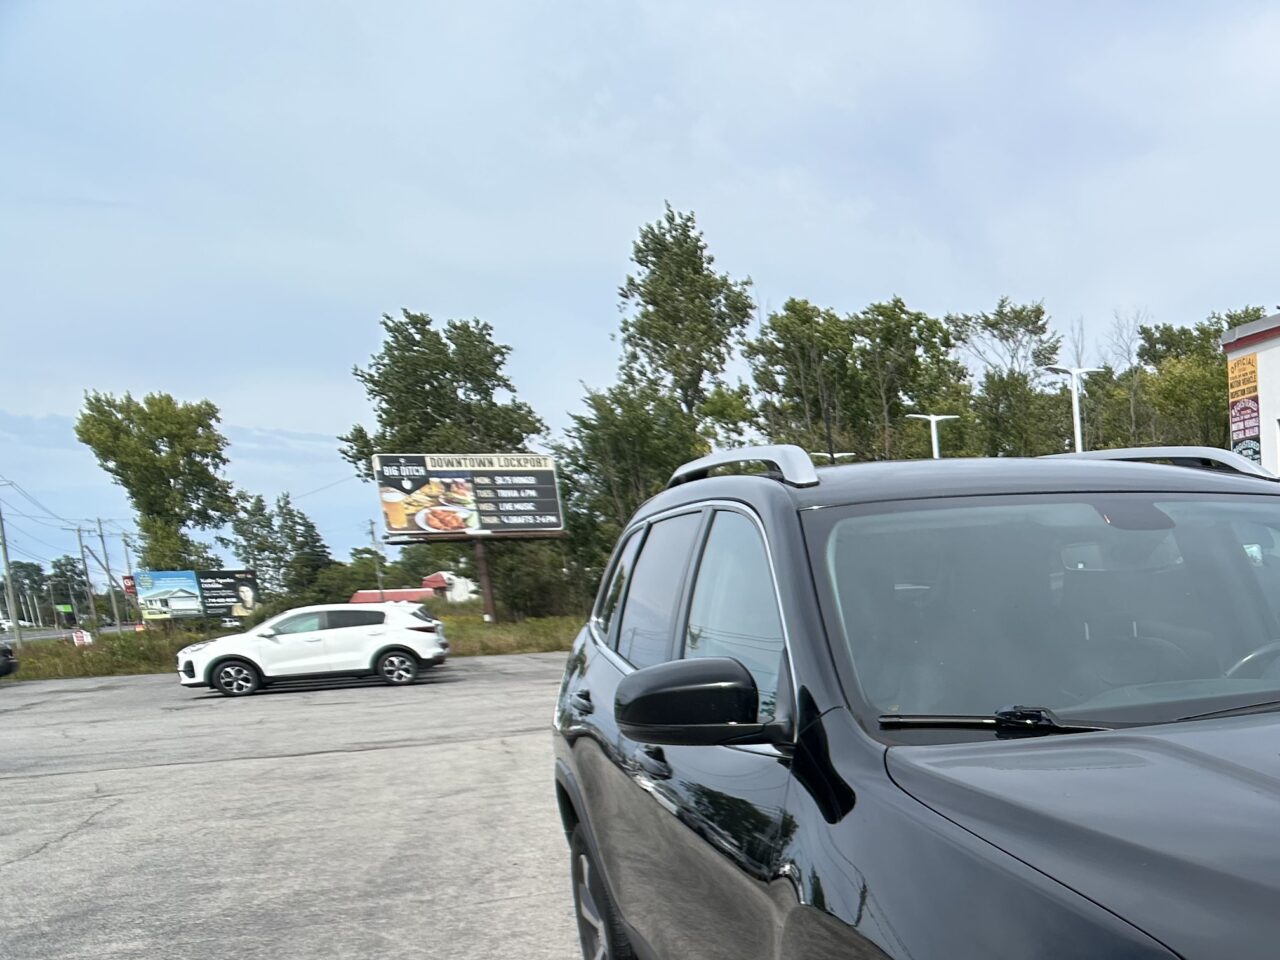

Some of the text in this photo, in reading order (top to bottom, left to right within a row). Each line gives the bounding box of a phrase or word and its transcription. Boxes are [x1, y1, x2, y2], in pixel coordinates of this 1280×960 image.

[1231, 357, 1255, 374] OFFICIAL
[429, 457, 549, 468] DOWNTOWN LOCKPORT
[382, 466, 426, 476] BIG DITCH
[497, 489, 520, 498] TRIVIA
[499, 502, 513, 511] LIVE
[513, 502, 536, 511] MUSIC
